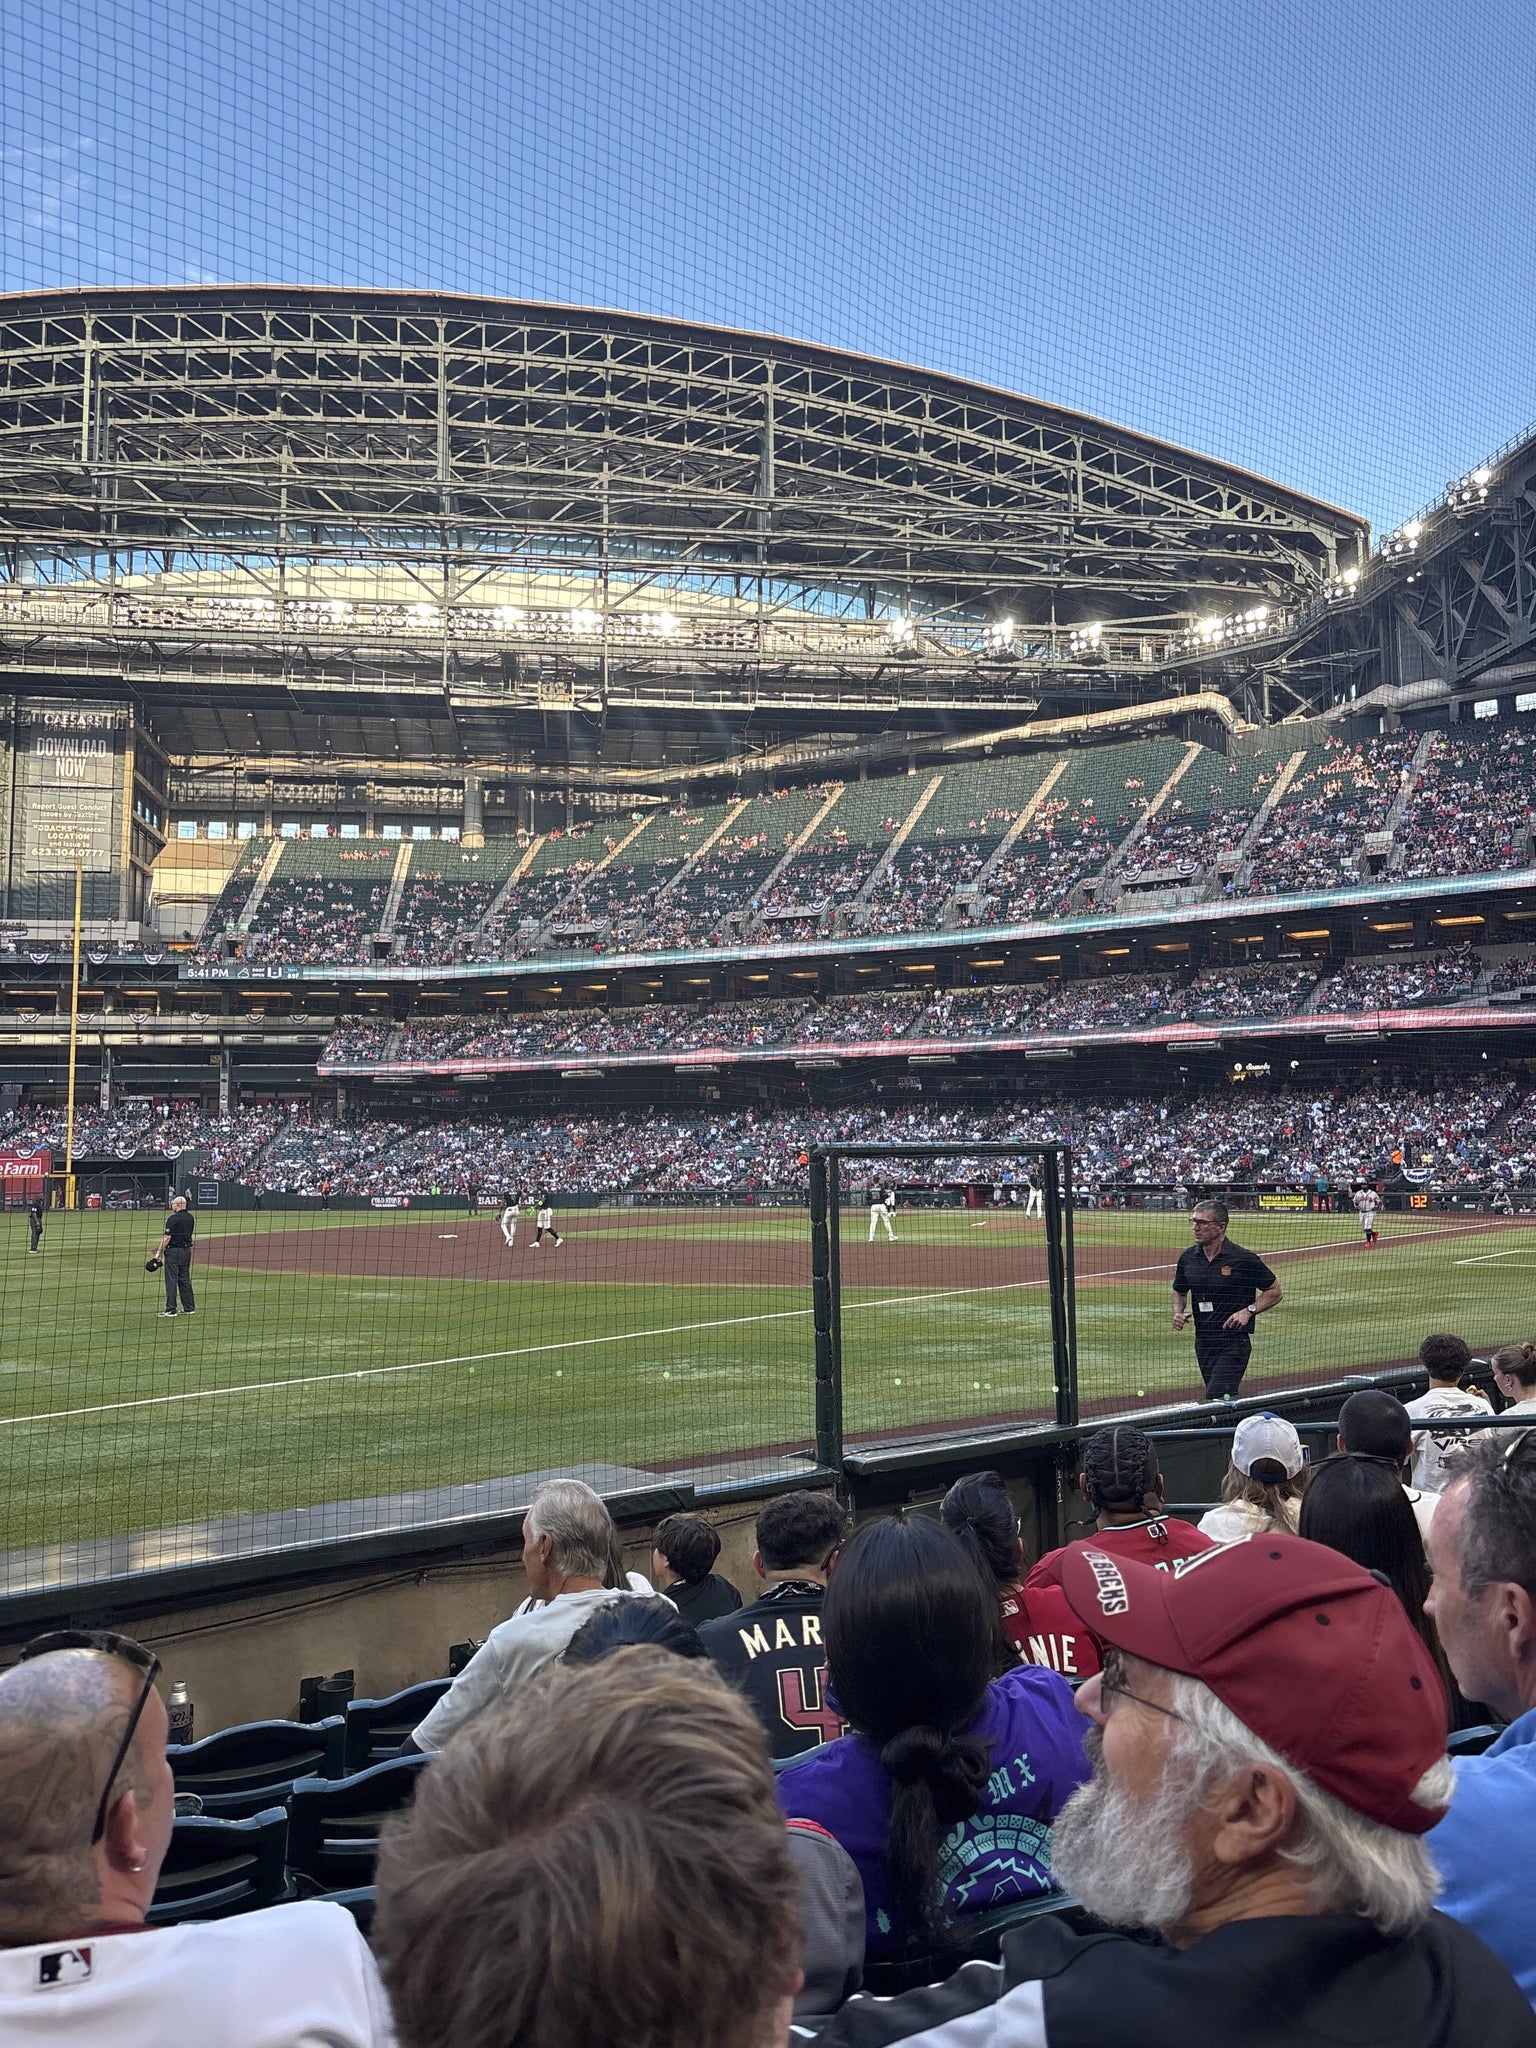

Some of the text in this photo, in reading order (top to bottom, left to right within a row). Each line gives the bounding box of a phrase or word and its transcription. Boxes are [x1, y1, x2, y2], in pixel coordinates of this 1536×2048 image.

[44, 714, 102, 728] CAESARS
[36, 737, 106, 757] DOWNLOAD
[56, 757, 86, 777] NOW
[32, 803, 56, 811] Report
[31, 848, 105, 857] 623.304.0777
[187, 968, 229, 977] 5:41 PM
[371, 1197, 385, 1206] COLD
[1081, 1551, 1129, 1616] DBACKS
[738, 1615, 824, 1660] MAR
